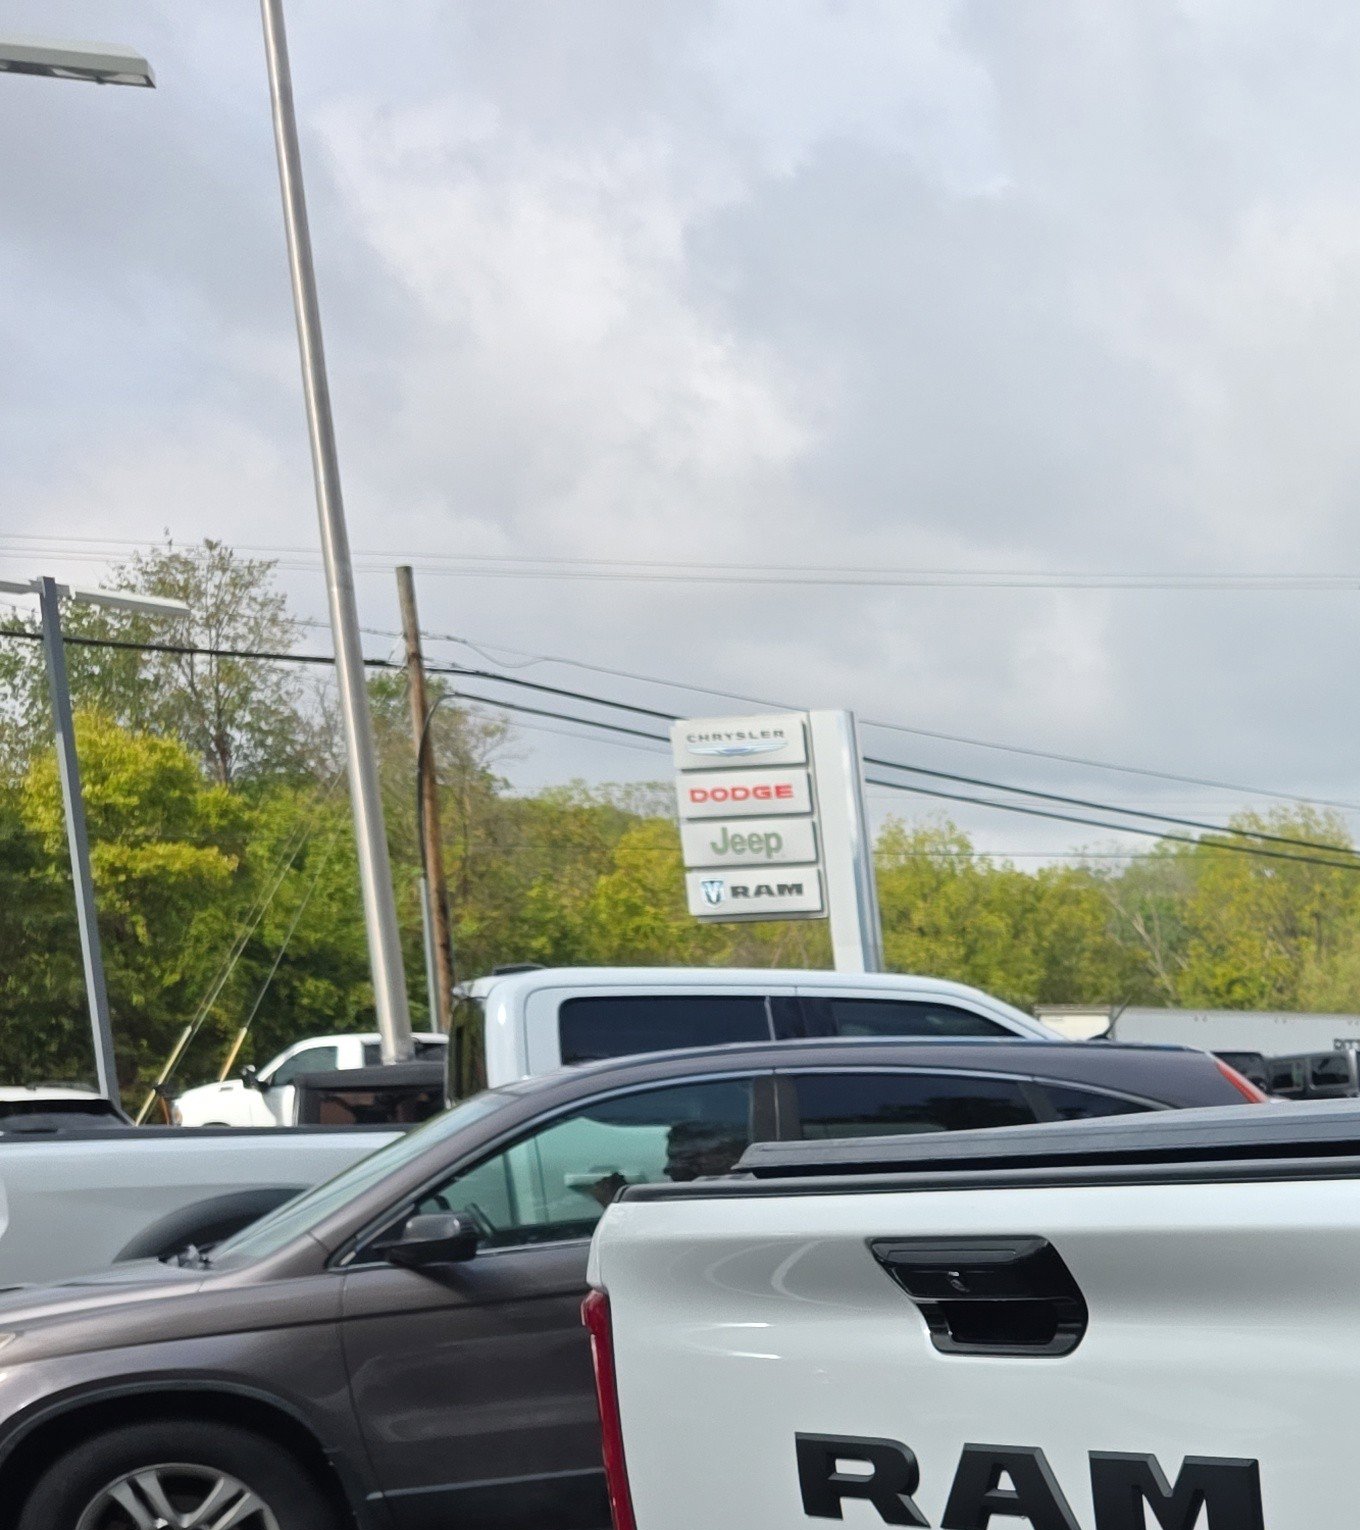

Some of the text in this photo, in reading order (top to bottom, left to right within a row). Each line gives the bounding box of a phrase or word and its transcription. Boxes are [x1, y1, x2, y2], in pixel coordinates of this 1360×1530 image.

[686, 729, 785, 743] CHRYSLER
[688, 784, 794, 803] DODGE
[710, 827, 783, 859] Jeep
[730, 883, 803, 898] RAM
